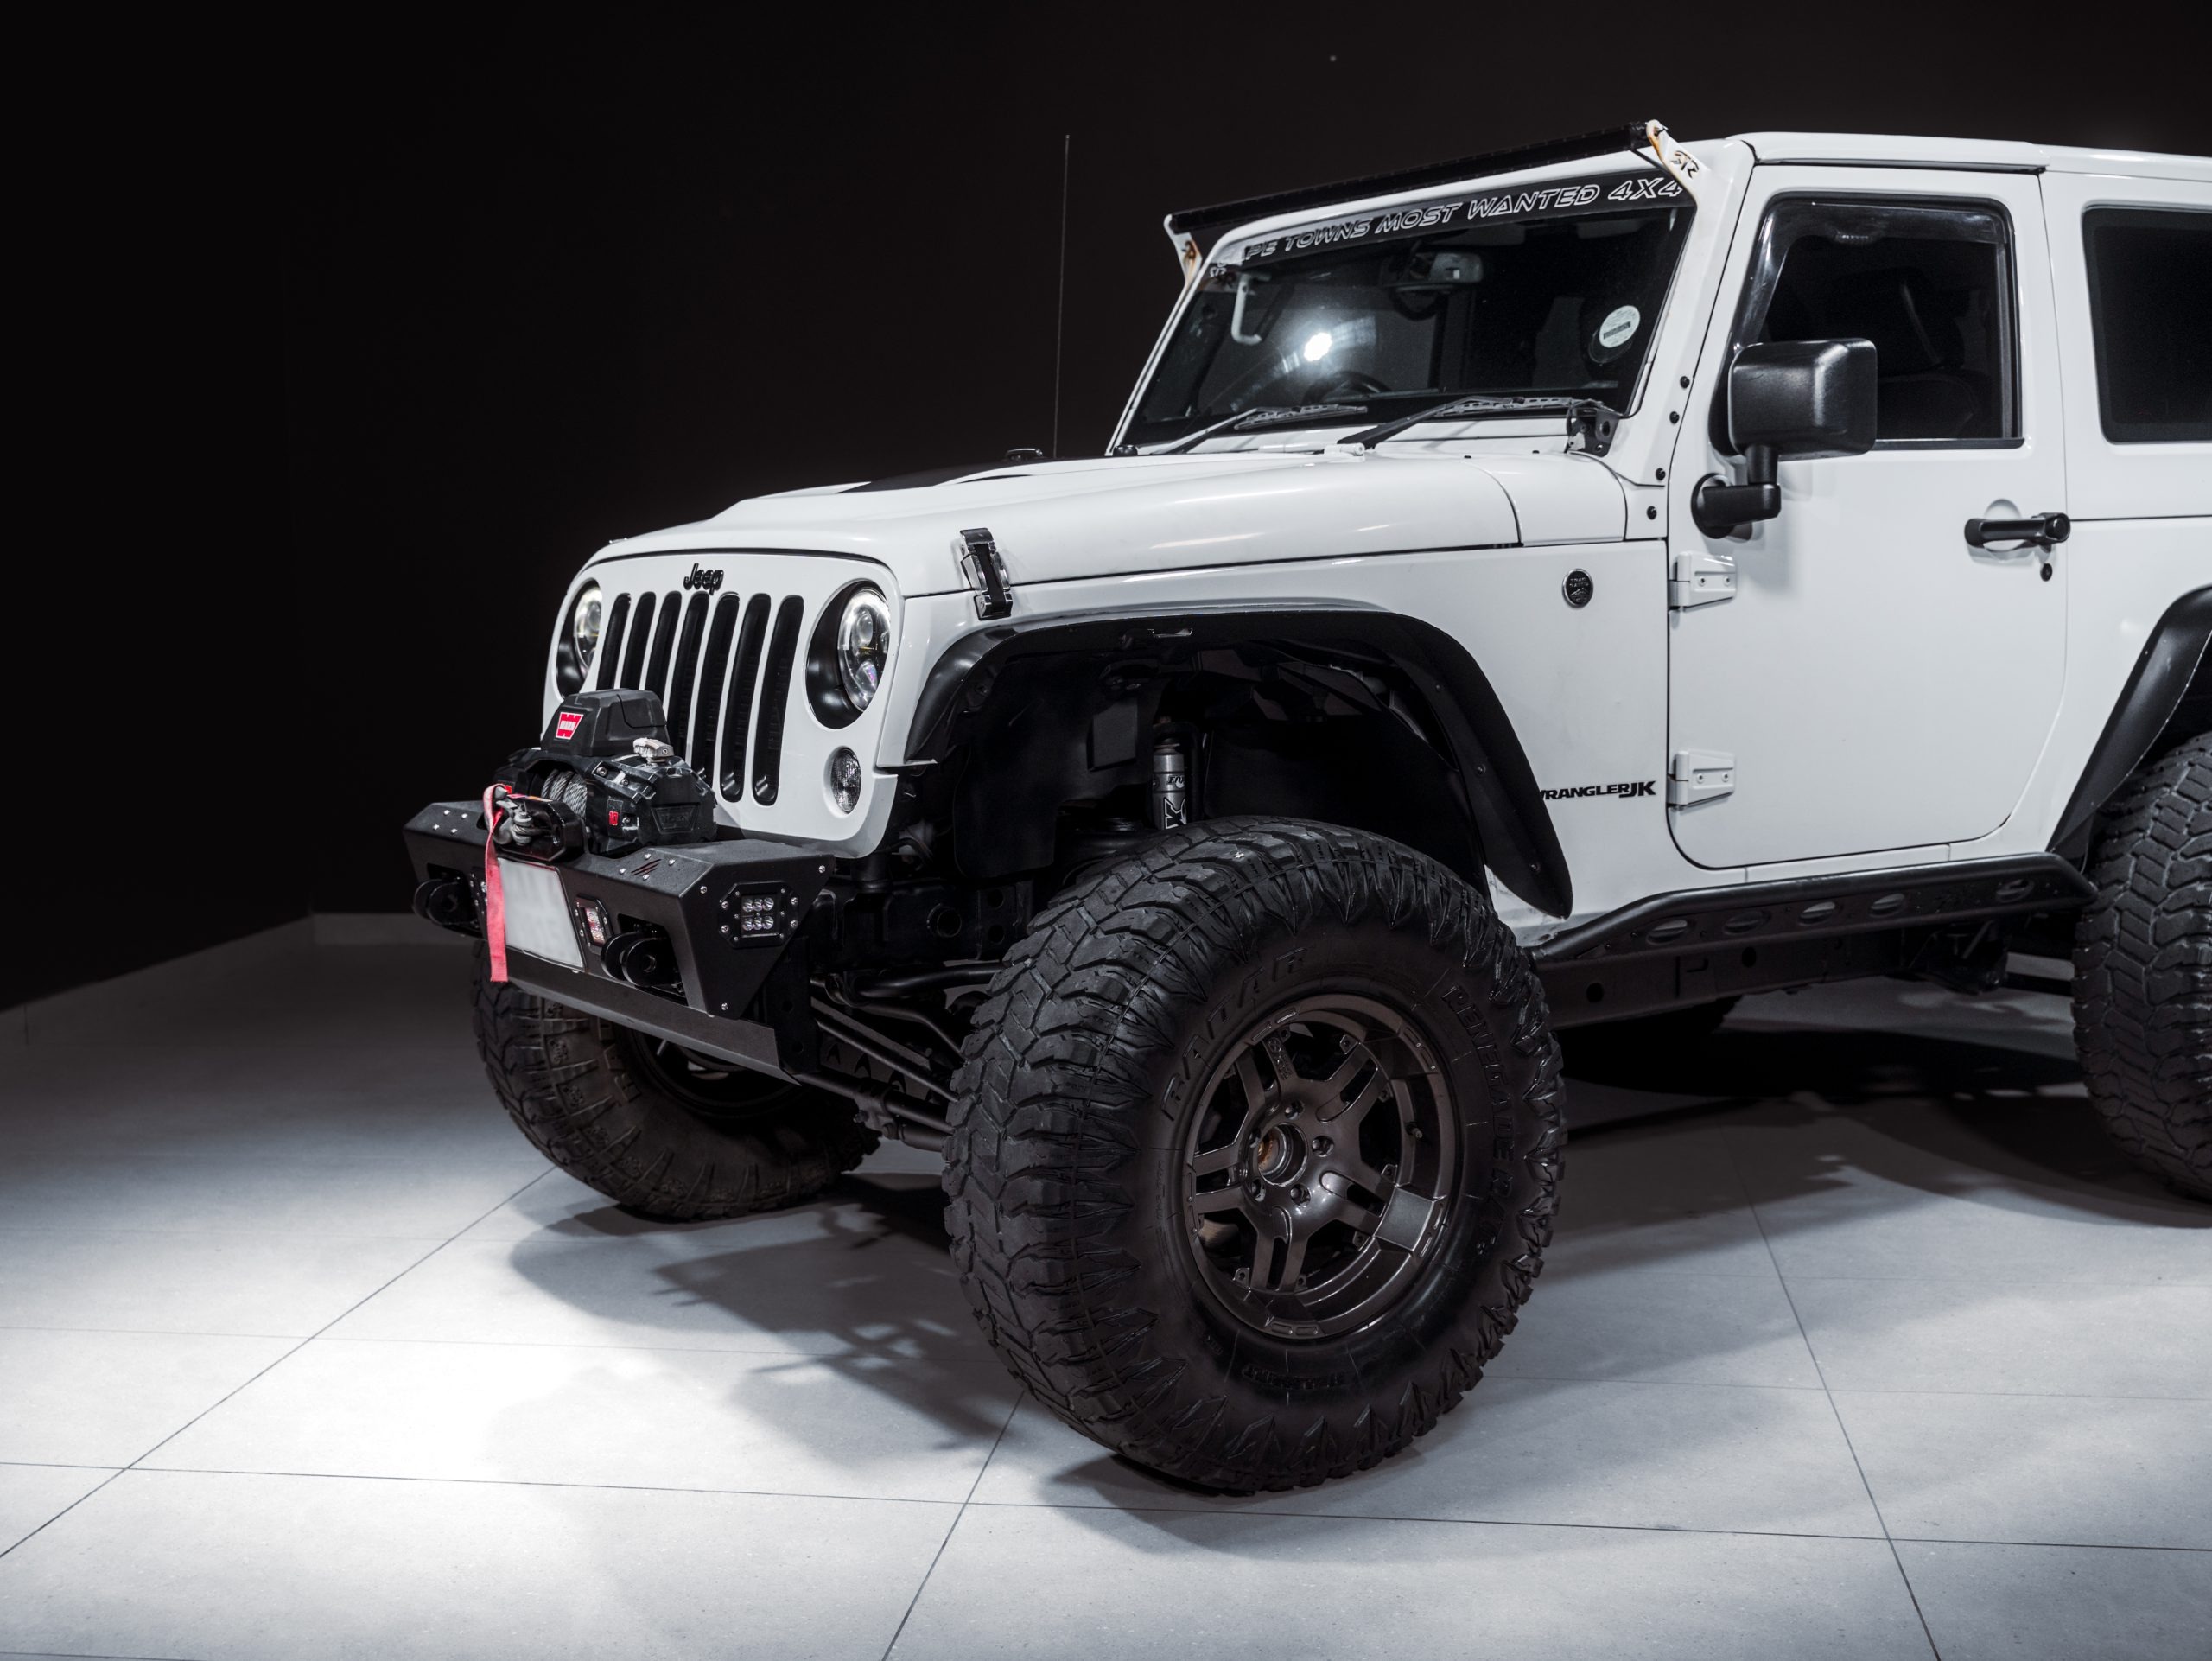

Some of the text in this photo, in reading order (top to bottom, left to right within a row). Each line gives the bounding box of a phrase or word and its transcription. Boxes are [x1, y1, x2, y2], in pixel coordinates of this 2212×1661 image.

[1284, 218, 1374, 251] TOWNS
[1374, 202, 1464, 234] MOST
[1467, 184, 1601, 220] WANTED
[1607, 177, 1683, 201] 4X4
[683, 563, 724, 595] Jeep
[609, 811, 618, 825] 10
[1441, 983, 1515, 1161] RENEGADE
